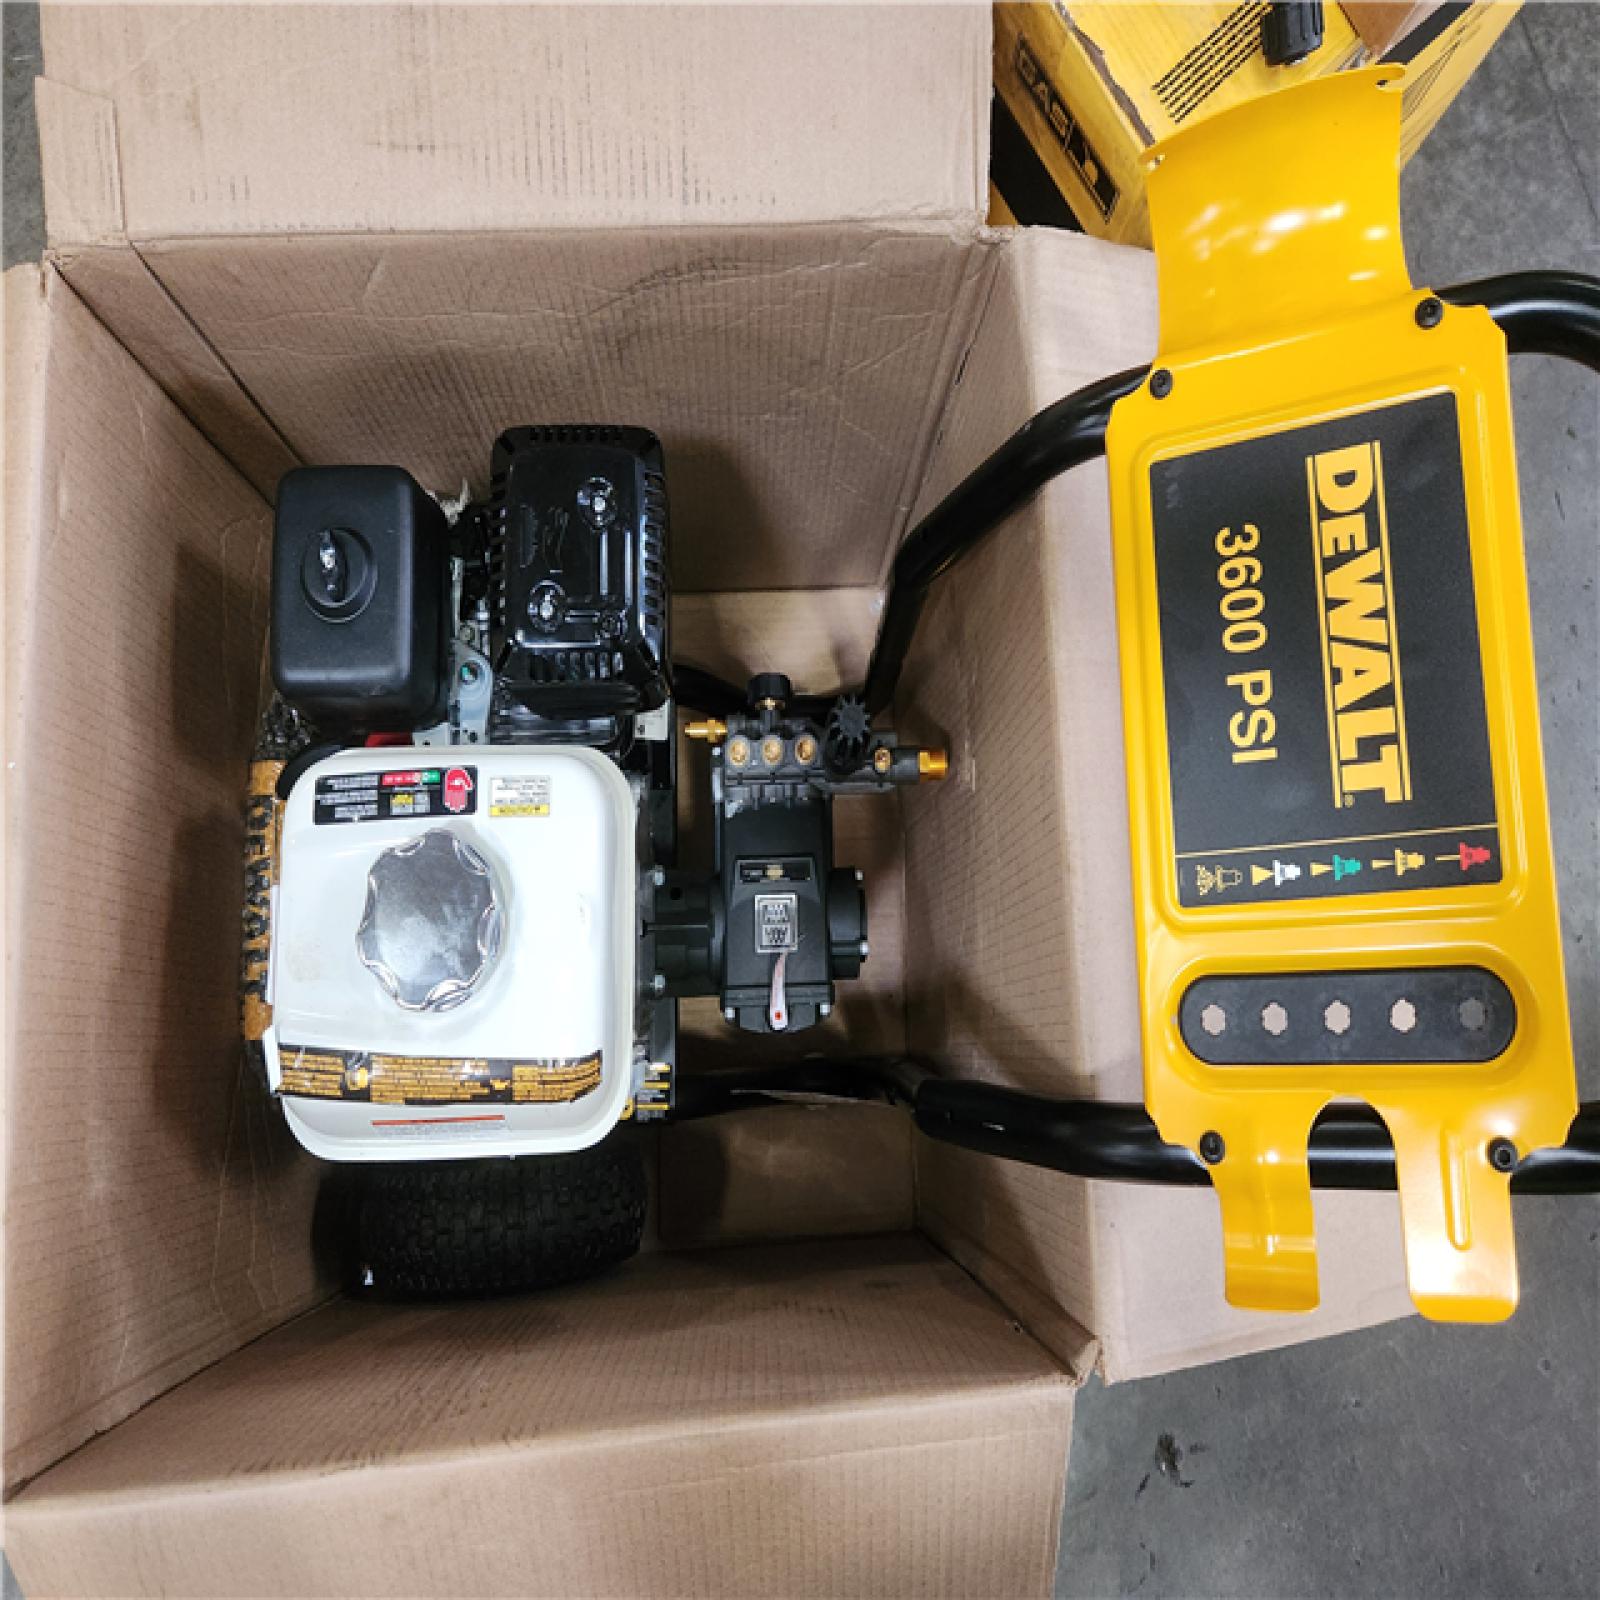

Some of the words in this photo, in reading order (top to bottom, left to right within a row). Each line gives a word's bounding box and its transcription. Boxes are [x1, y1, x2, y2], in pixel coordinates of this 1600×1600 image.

[1214, 523, 1268, 654] 3600
[1314, 442, 1404, 804] DEWALT
[1226, 669, 1279, 764] PSI
